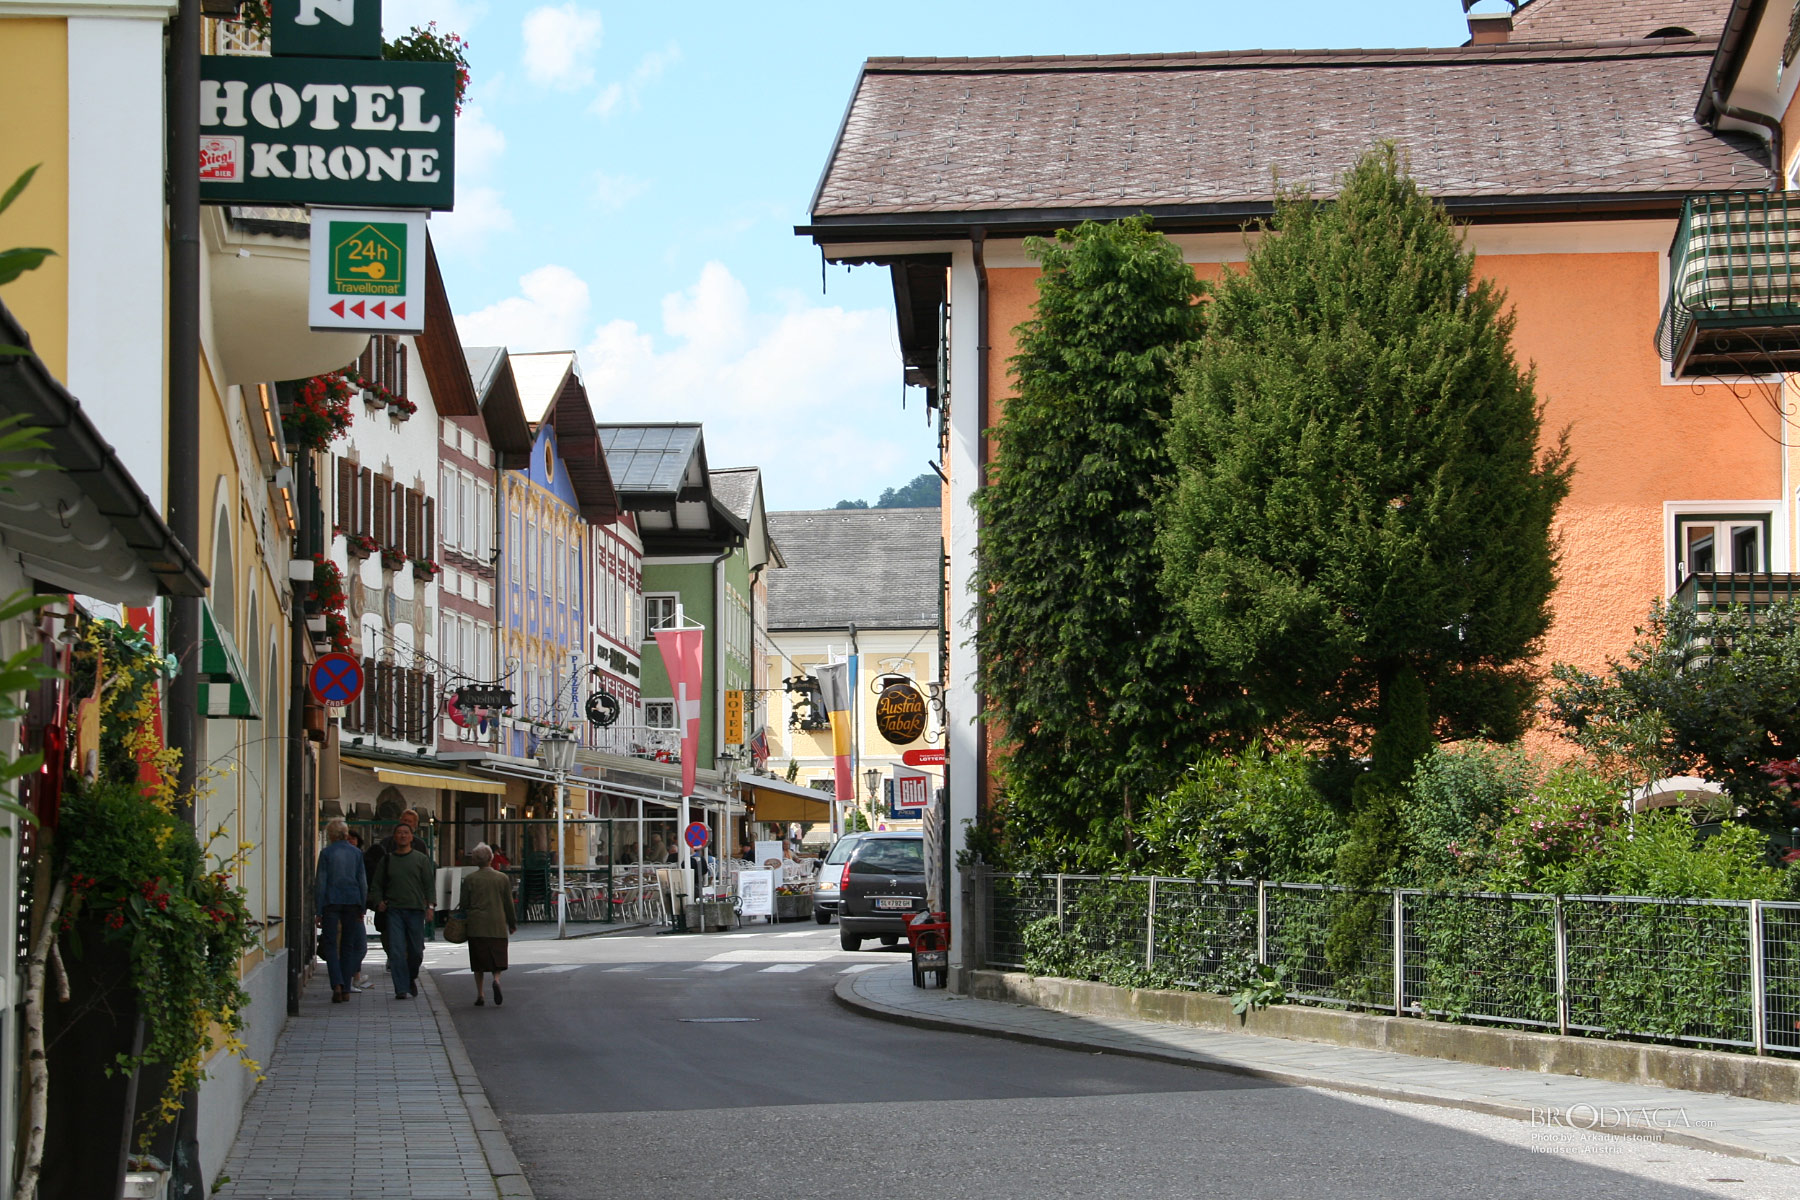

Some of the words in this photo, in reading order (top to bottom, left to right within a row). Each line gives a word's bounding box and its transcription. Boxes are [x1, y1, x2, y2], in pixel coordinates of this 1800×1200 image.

[200, 80, 441, 133] HOTEL
[250, 143, 440, 183] KRONE
[348, 239, 388, 260] 24h
[335, 281, 400, 294] Travellomat
[571, 655, 579, 718] PIZZERIA
[728, 691, 738, 736] HOTEL
[878, 697, 922, 715] Austria
[880, 713, 924, 733] Tabak
[902, 780, 925, 803] Bild
